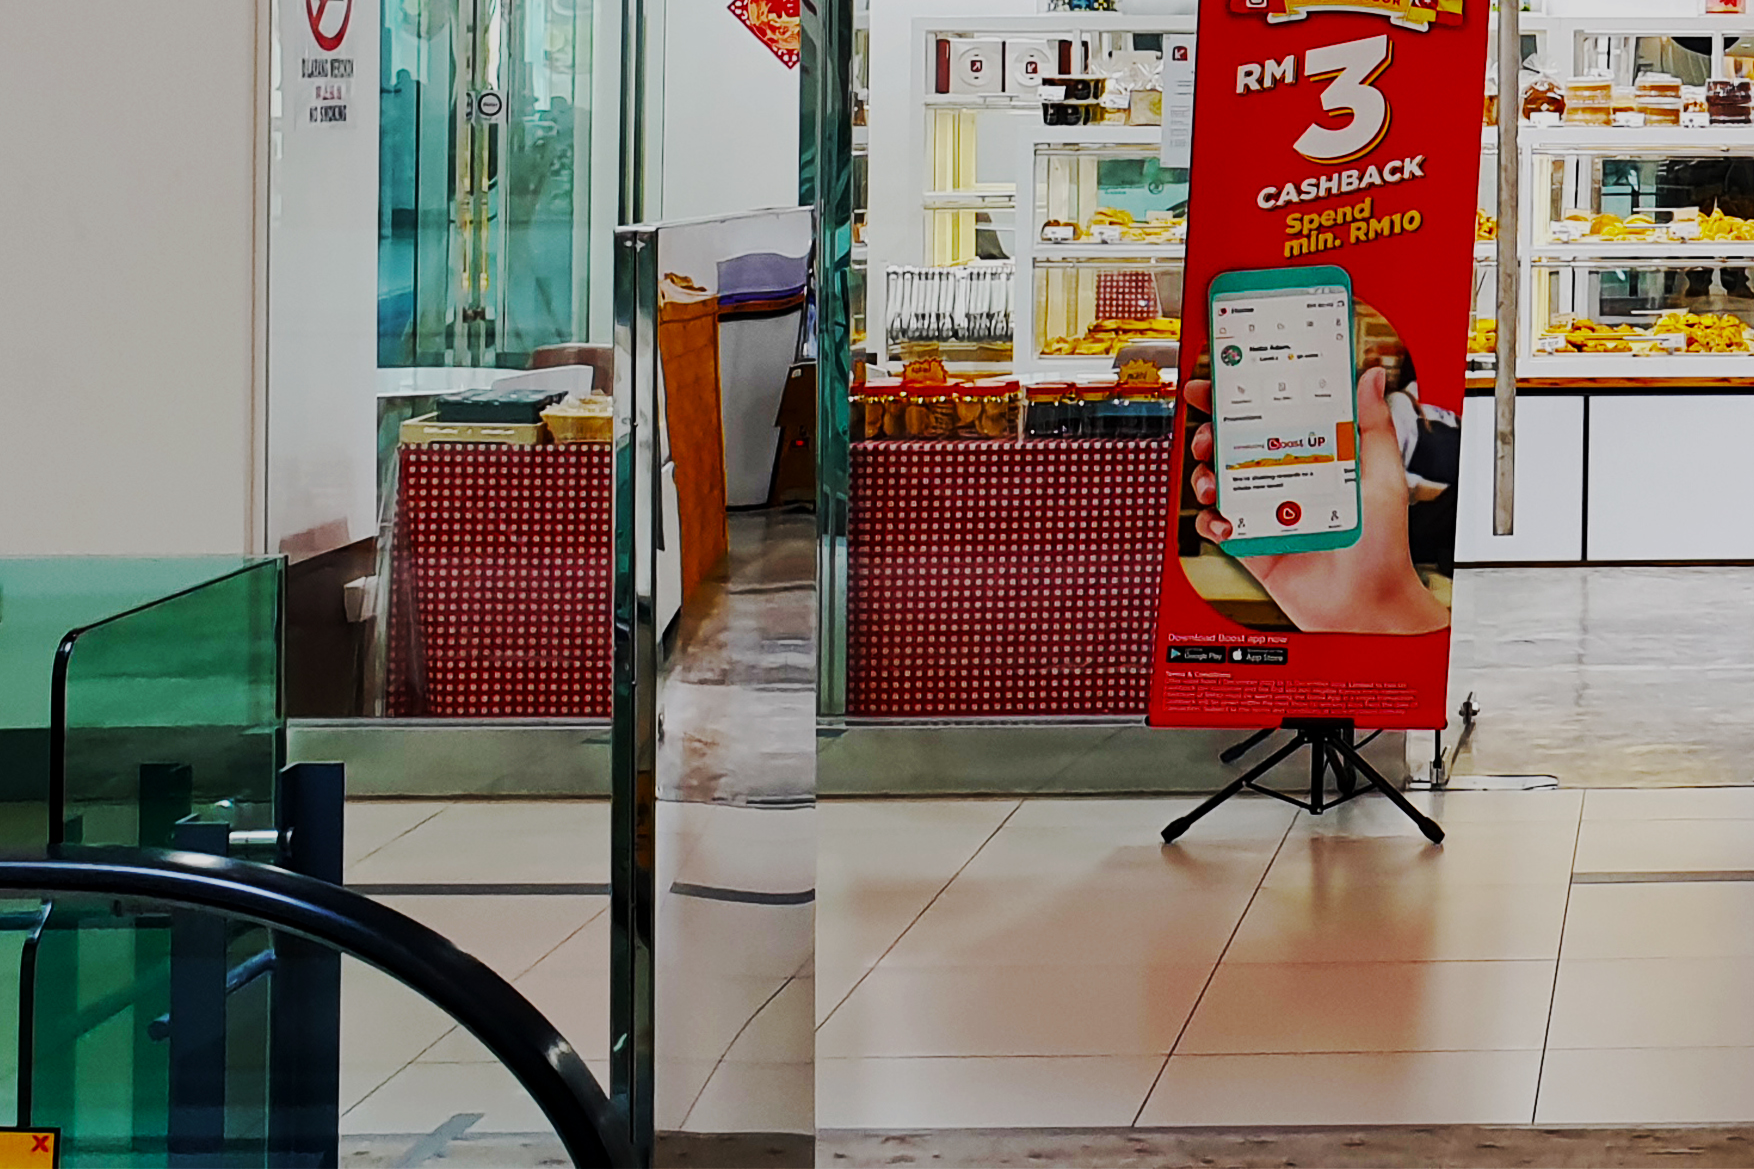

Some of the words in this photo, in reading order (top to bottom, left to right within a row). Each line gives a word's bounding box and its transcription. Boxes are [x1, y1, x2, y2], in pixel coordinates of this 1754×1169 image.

[1236, 55, 1297, 95] RM
[1292, 34, 1393, 165] 3
[1256, 155, 1426, 210] CASHBACK
[1284, 232, 1344, 260] min.
[1350, 209, 1423, 245] RM10
[1285, 197, 1374, 235] Spend
